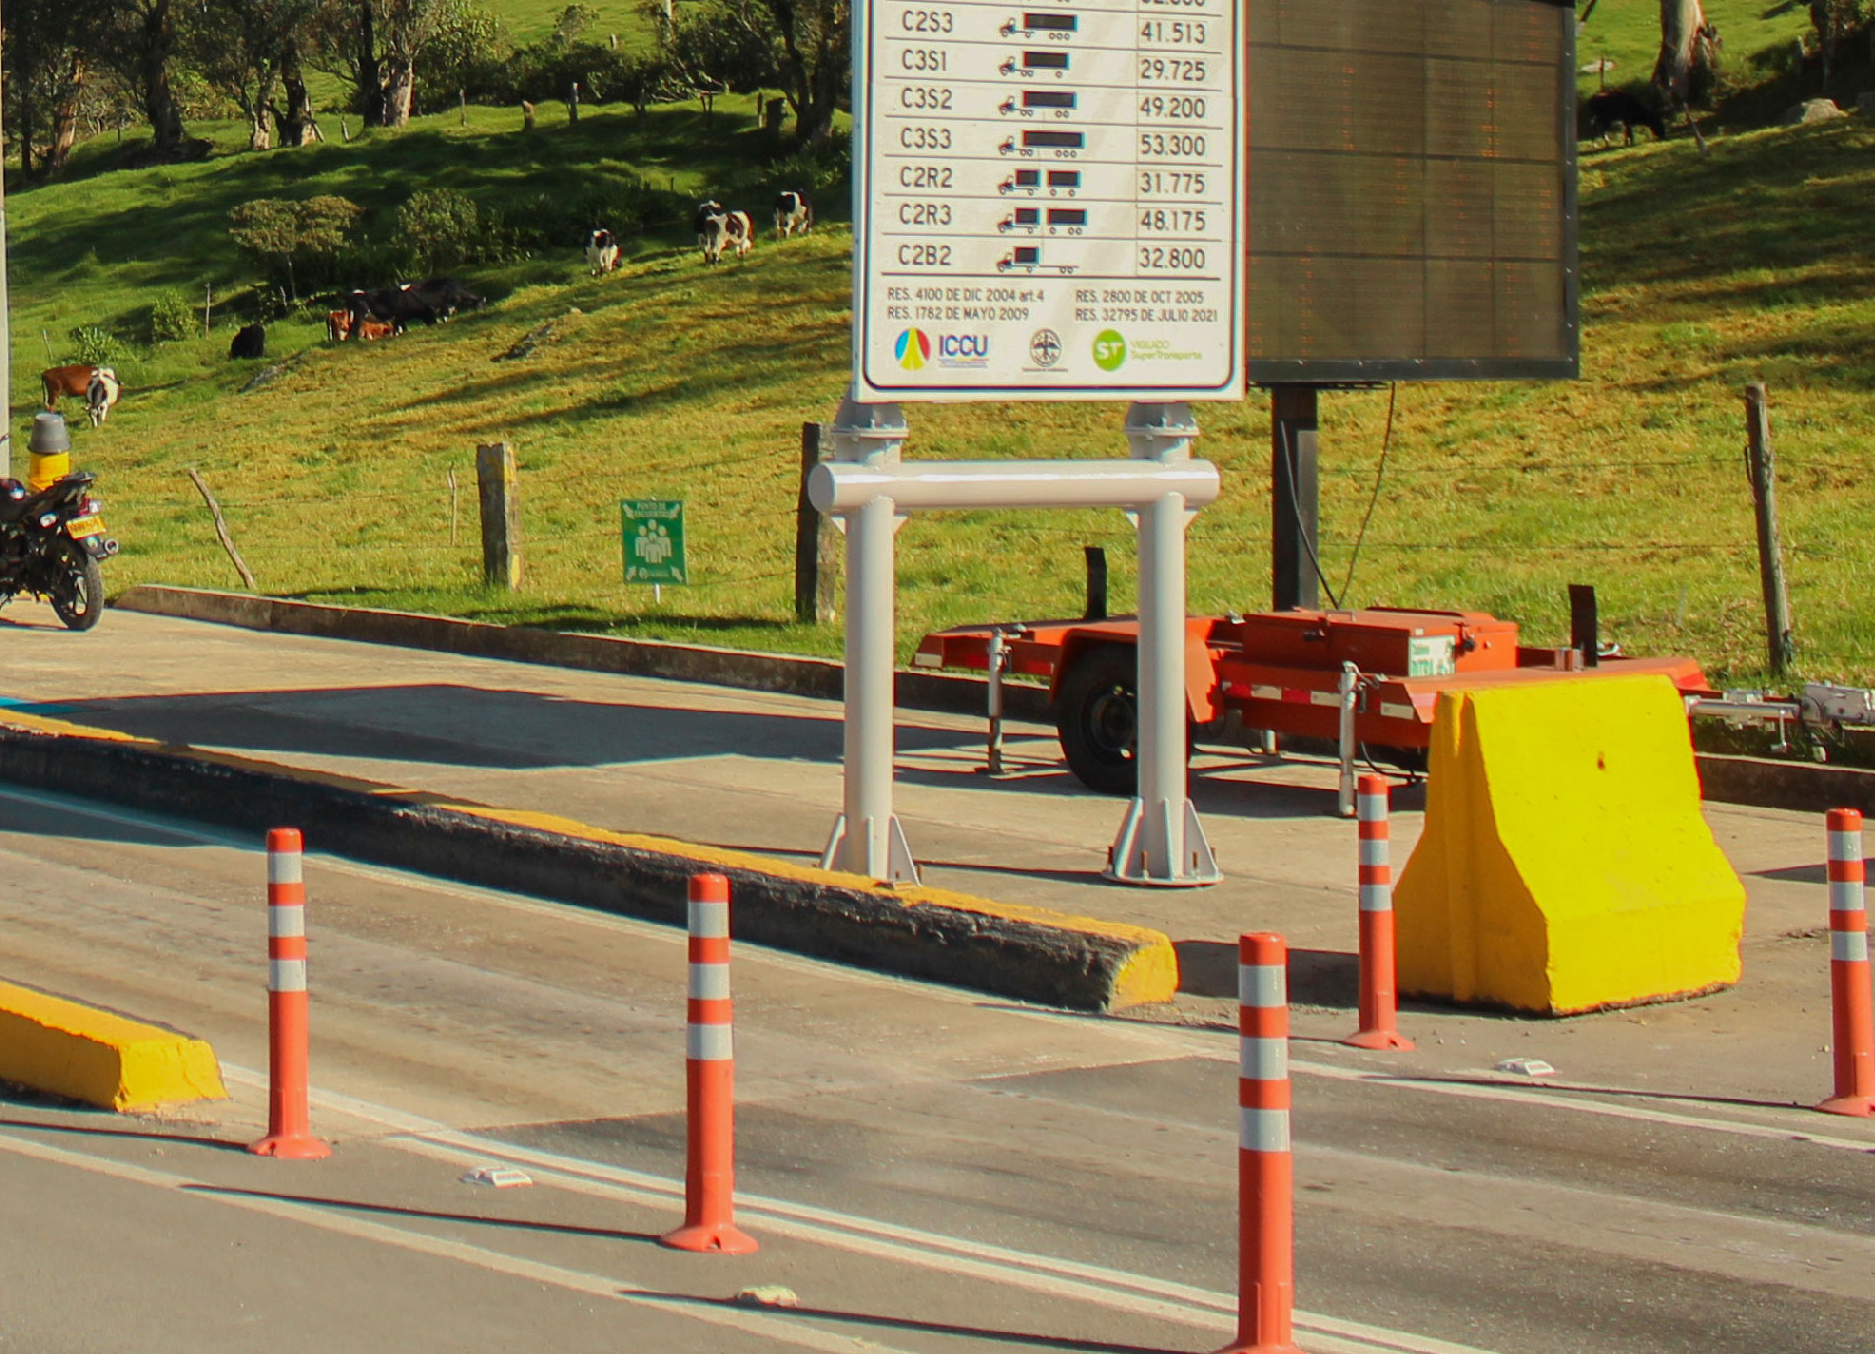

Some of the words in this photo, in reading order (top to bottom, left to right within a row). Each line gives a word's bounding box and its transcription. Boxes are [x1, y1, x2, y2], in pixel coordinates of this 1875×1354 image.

[902, 10, 952, 33] C2S3
[1141, 22, 1205, 44] 41.513
[902, 49, 946, 71] C3S1
[1141, 59, 1205, 81] 29.725
[901, 87, 952, 110] C3S2
[1140, 96, 1205, 118] 49.200
[901, 127, 951, 149] C3S3
[1142, 134, 1205, 156] 53.300
[900, 166, 952, 188] C2R2
[1140, 172, 1204, 194] 31.775
[899, 203, 951, 225] C2R3
[1141, 207, 1205, 231] 48.175
[899, 244, 951, 265] C2B2
[1140, 247, 1205, 269] 32.800
[888, 287, 912, 301] RES.
[915, 288, 943, 301] 4100
[946, 288, 960, 301] DE
[964, 288, 982, 302] DIC
[987, 288, 1015, 302] 2004
[1076, 290, 1098, 303] RES.
[1103, 290, 1131, 303] 2800
[1134, 290, 1147, 303] DE
[1151, 290, 1171, 304] OCT
[1175, 291, 1204, 304] 2005
[888, 306, 912, 319] RES.
[946, 307, 959, 320] DE
[964, 307, 995, 320] MAYO
[999, 307, 1029, 320] 2009
[1075, 308, 1098, 321] RES.
[1102, 308, 1137, 322] 32795
[1141, 309, 1154, 321] DE
[1158, 309, 1188, 322] JULIO
[1192, 309, 1217, 322] 2021
[939, 334, 989, 357] ICCU
[1096, 342, 1125, 359] ST
